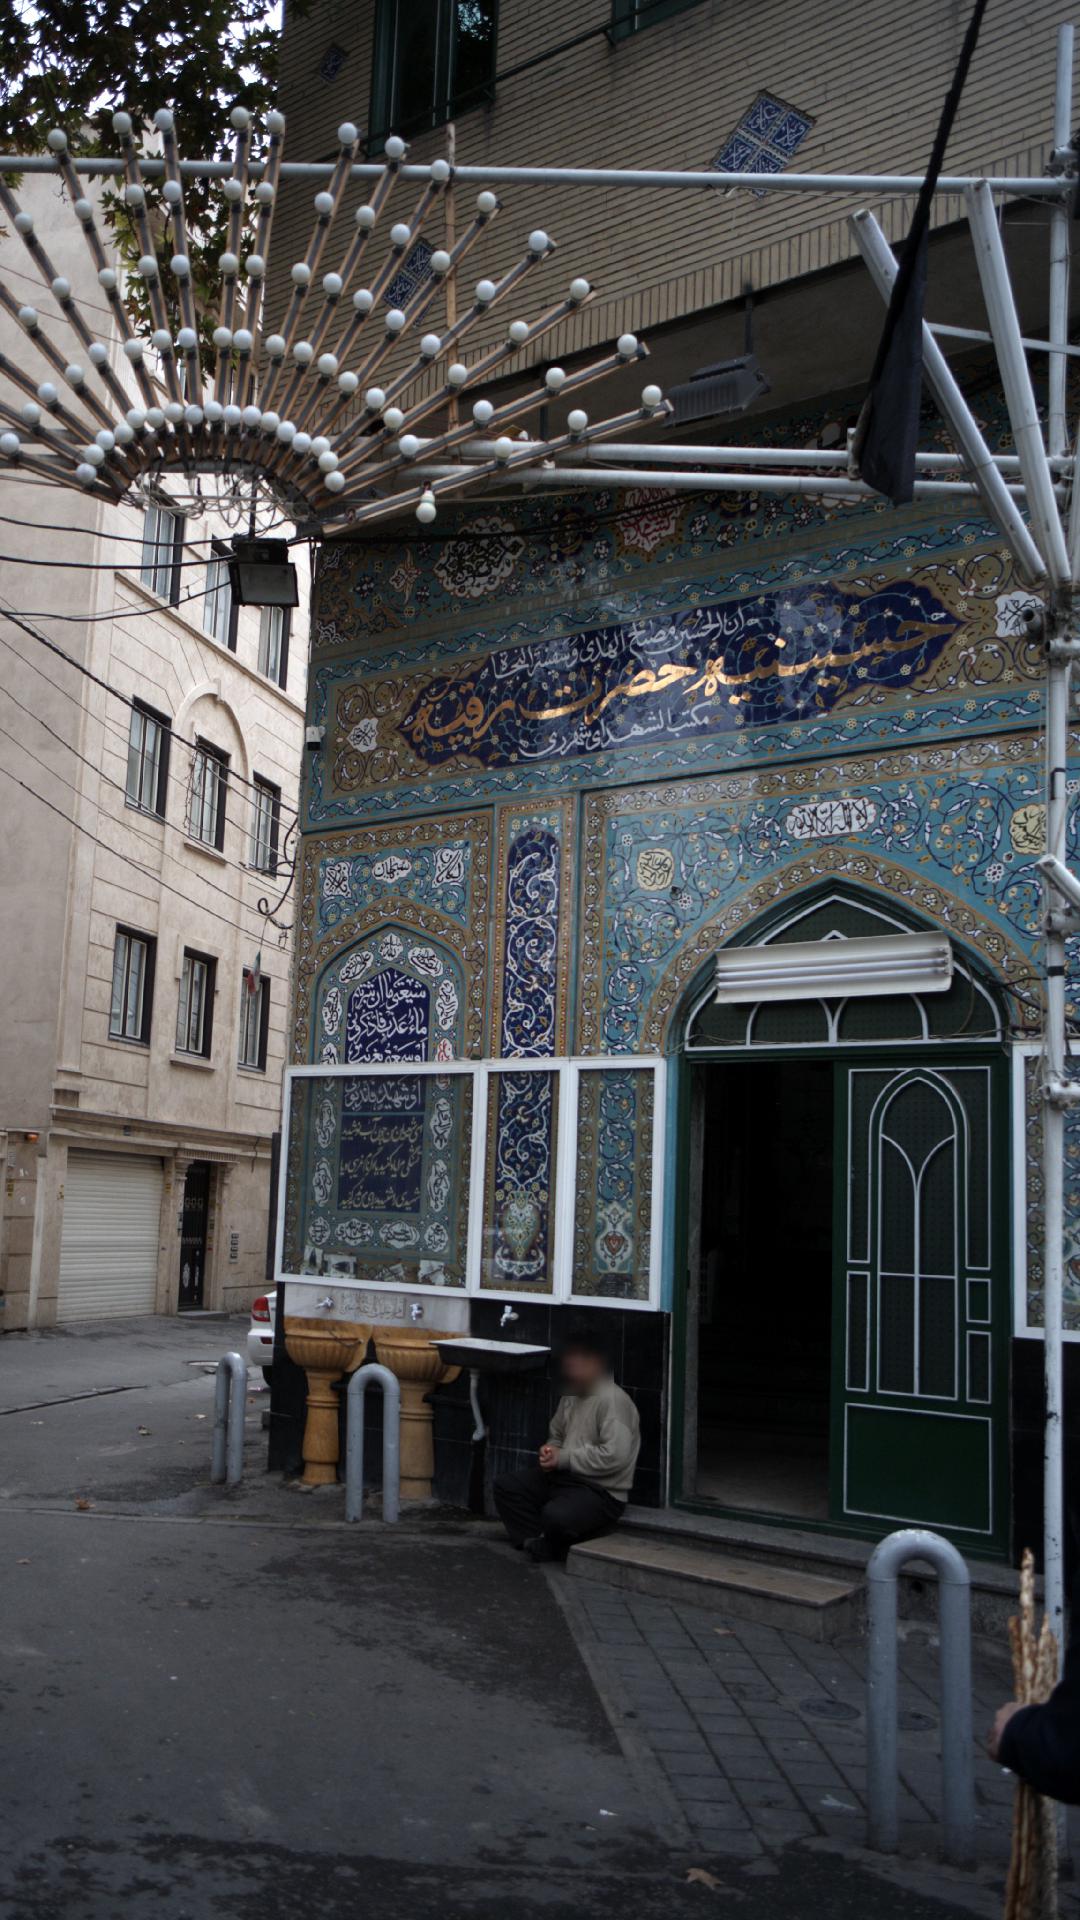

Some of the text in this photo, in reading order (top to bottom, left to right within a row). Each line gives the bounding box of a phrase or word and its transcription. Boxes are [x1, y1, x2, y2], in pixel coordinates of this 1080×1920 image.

[682, 619, 959, 705] حسینیه
[401, 682, 515, 743] رقیه
[519, 664, 698, 726] حضرت
[668, 700, 713, 738] مکتب
